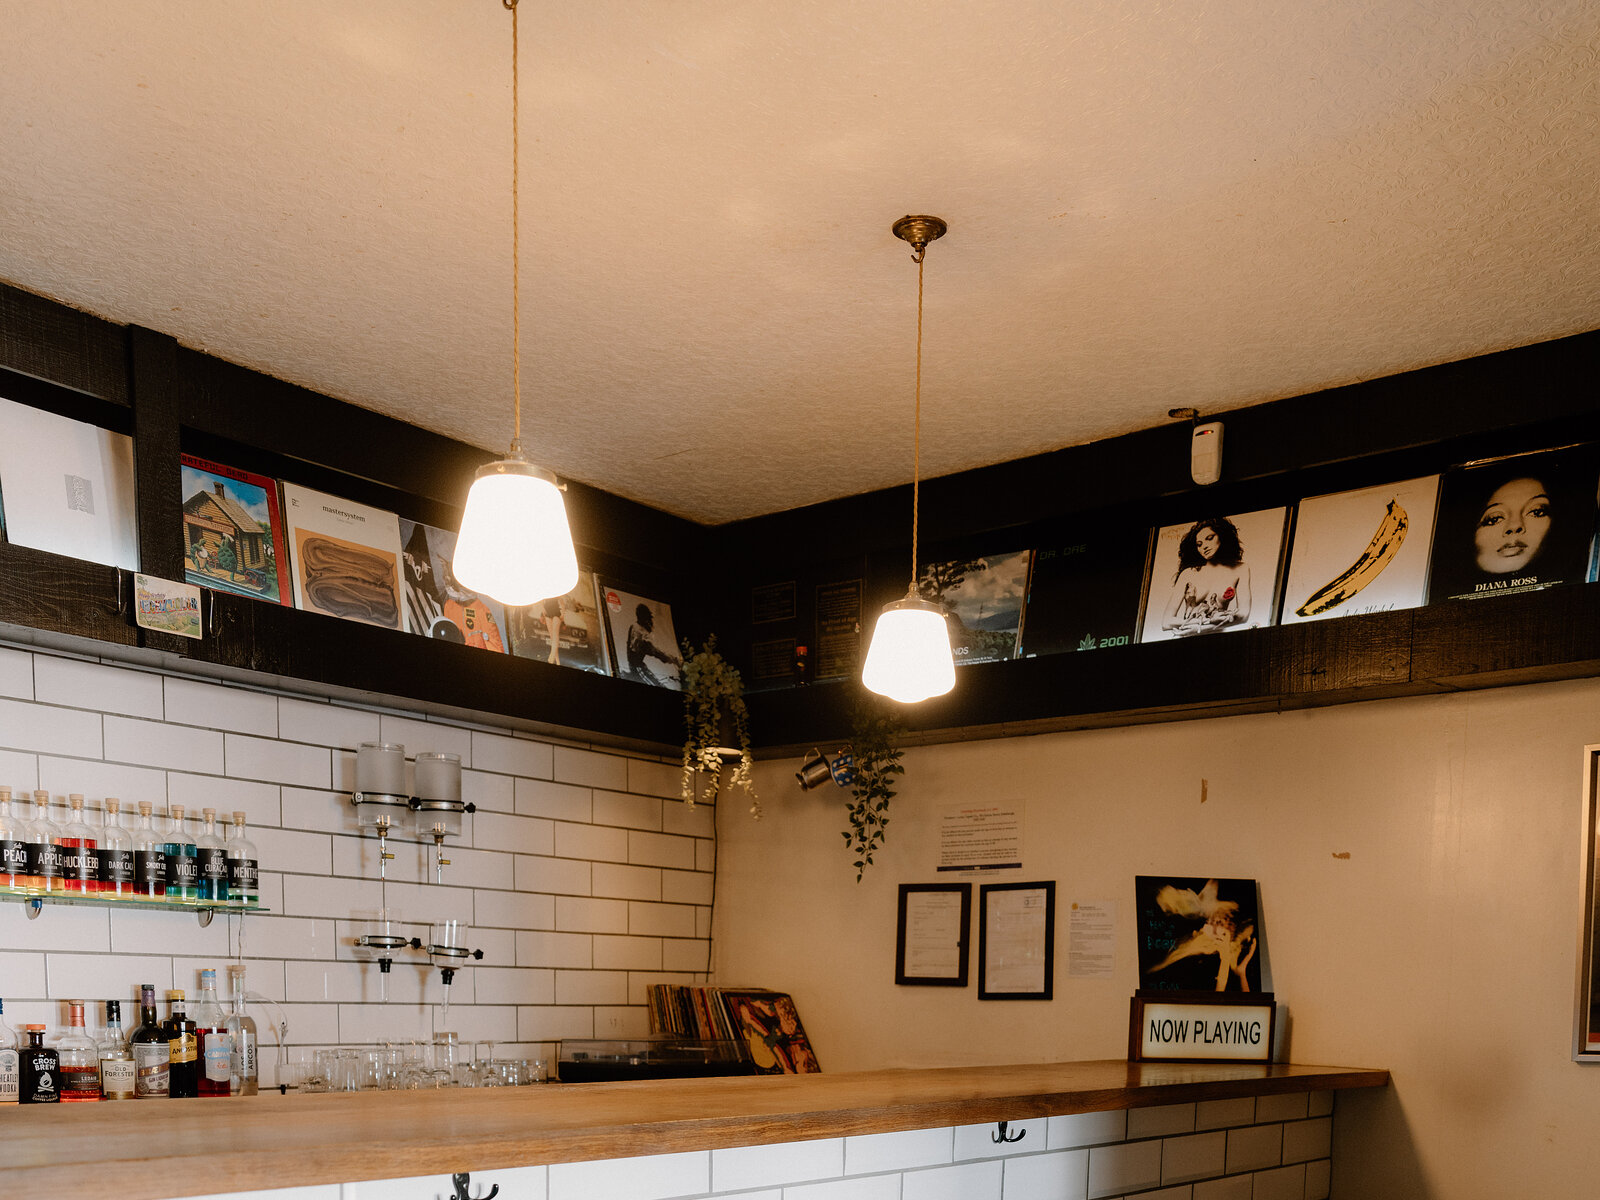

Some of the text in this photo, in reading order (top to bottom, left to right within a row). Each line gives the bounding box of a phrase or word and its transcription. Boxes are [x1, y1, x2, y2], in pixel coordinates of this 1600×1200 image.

[322, 505, 367, 522] mastersystem
[1475, 580, 1508, 592] DIANA
[1511, 576, 1538, 588] ROSS
[1099, 635, 1130, 649] 2001
[38, 852, 62, 867] APPLE
[108, 861, 124, 870] DARK
[210, 856, 224, 866] BLUE
[1150, 1019, 1261, 1045] NOW PLAYING
